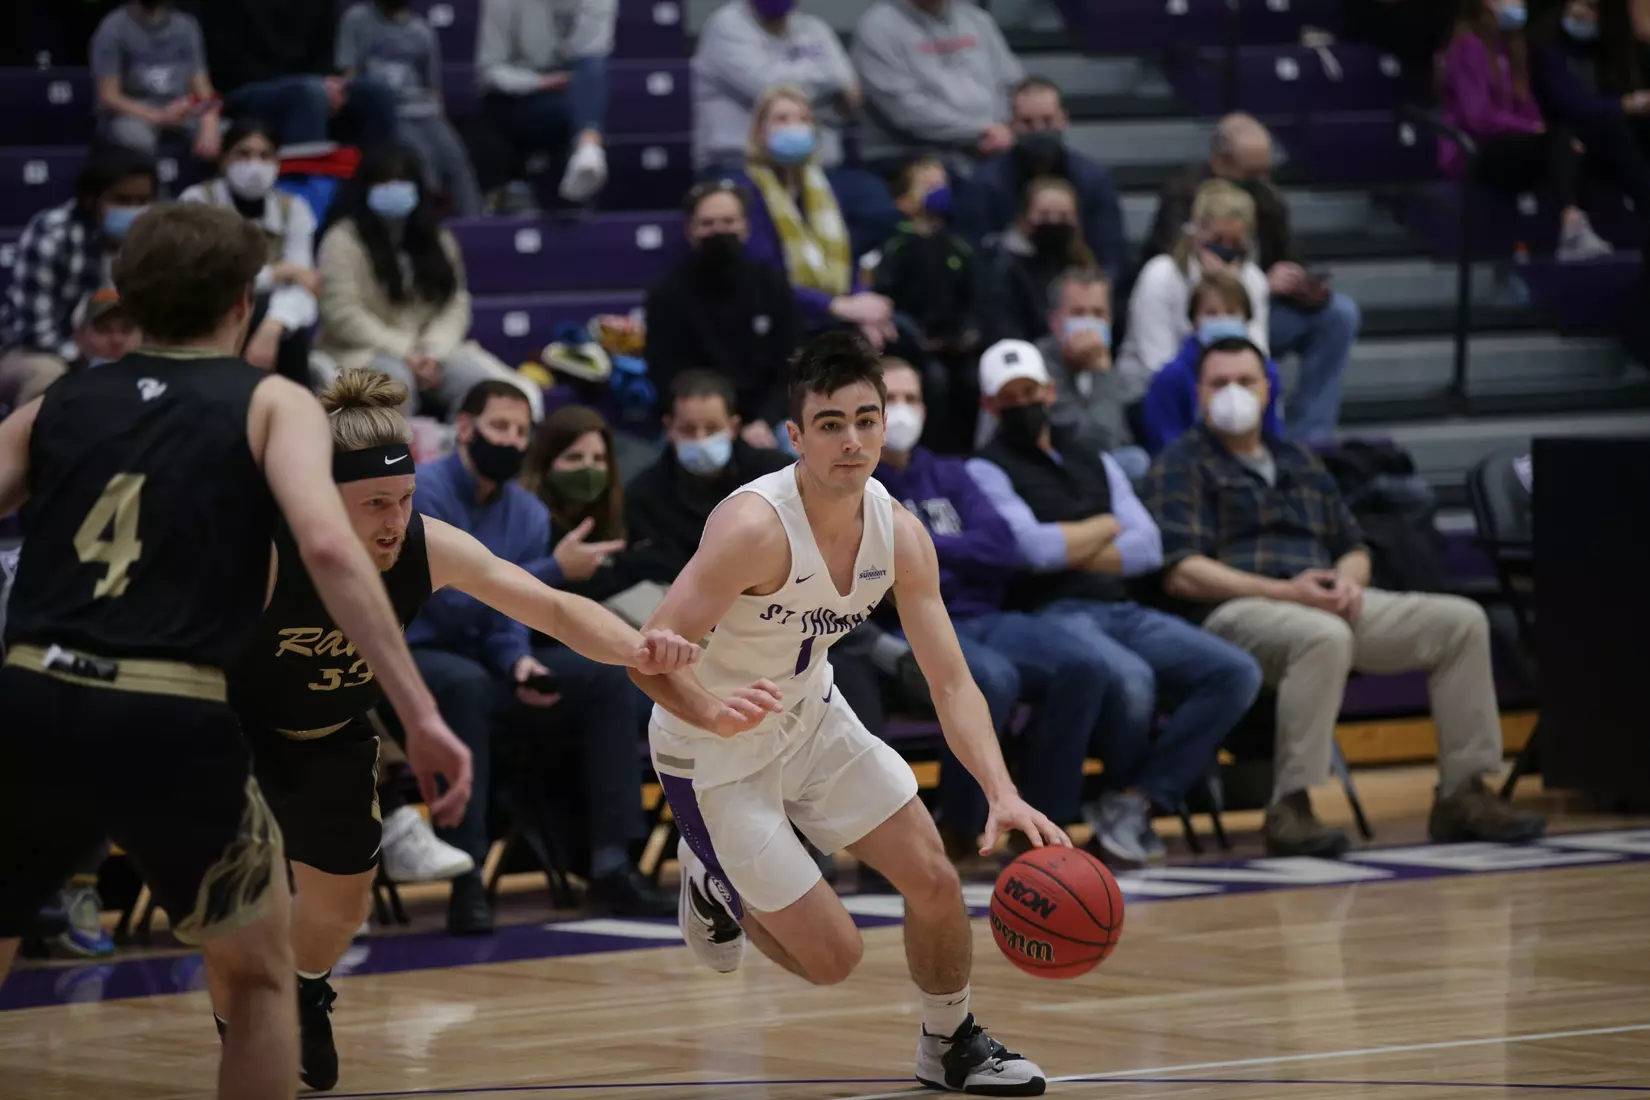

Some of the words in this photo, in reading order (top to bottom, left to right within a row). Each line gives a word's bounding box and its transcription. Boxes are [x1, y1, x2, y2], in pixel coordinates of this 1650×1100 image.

[73, 472, 146, 600] 4
[801, 600, 876, 636] THOMA
[790, 635, 817, 680] 1
[1004, 876, 1057, 920] NCAA
